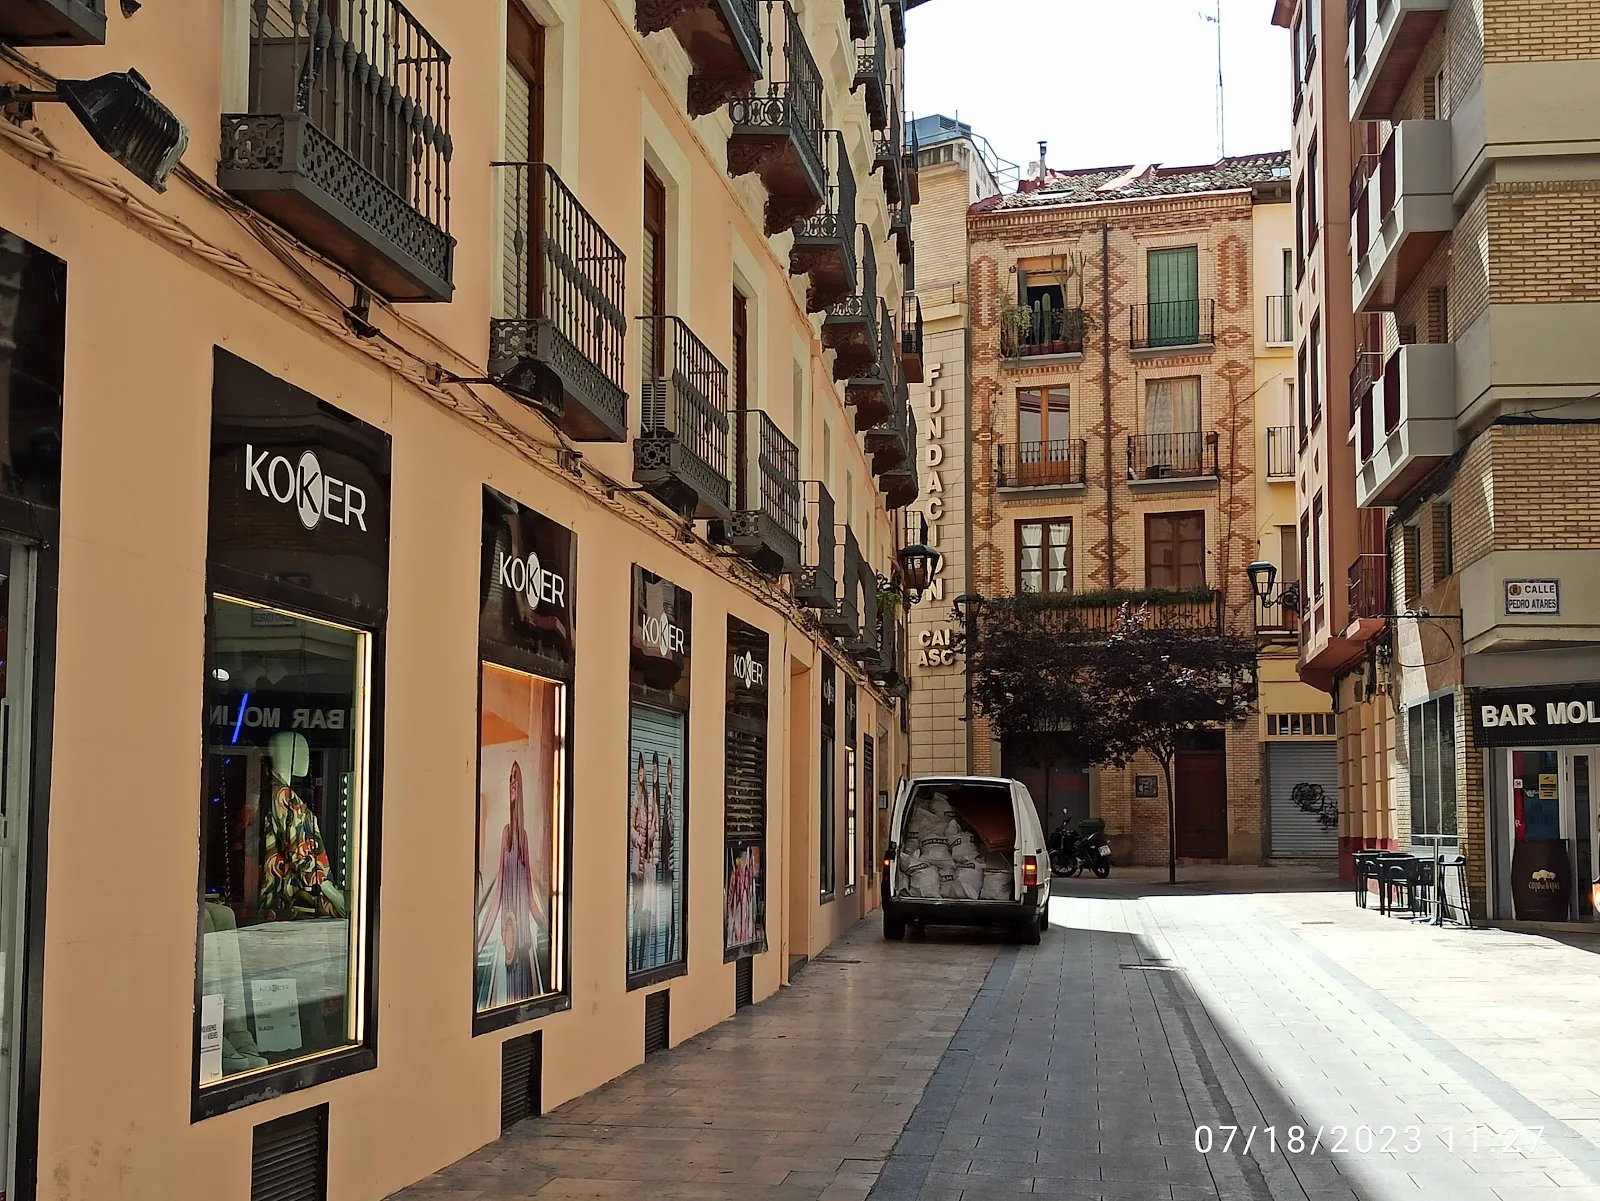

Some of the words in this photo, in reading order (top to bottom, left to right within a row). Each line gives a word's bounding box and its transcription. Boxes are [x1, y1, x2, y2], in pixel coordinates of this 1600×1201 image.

[245, 443, 368, 531] KOKER
[500, 551, 565, 610] KOKER
[1524, 585, 1555, 593] CALLE
[1509, 599, 1530, 608] PEDRO
[1531, 599, 1557, 608] ATARES
[642, 612, 685, 656] KOKER
[733, 650, 763, 689] KOKER
[1481, 703, 1538, 727] BAR
[1546, 700, 1600, 725] MOL
